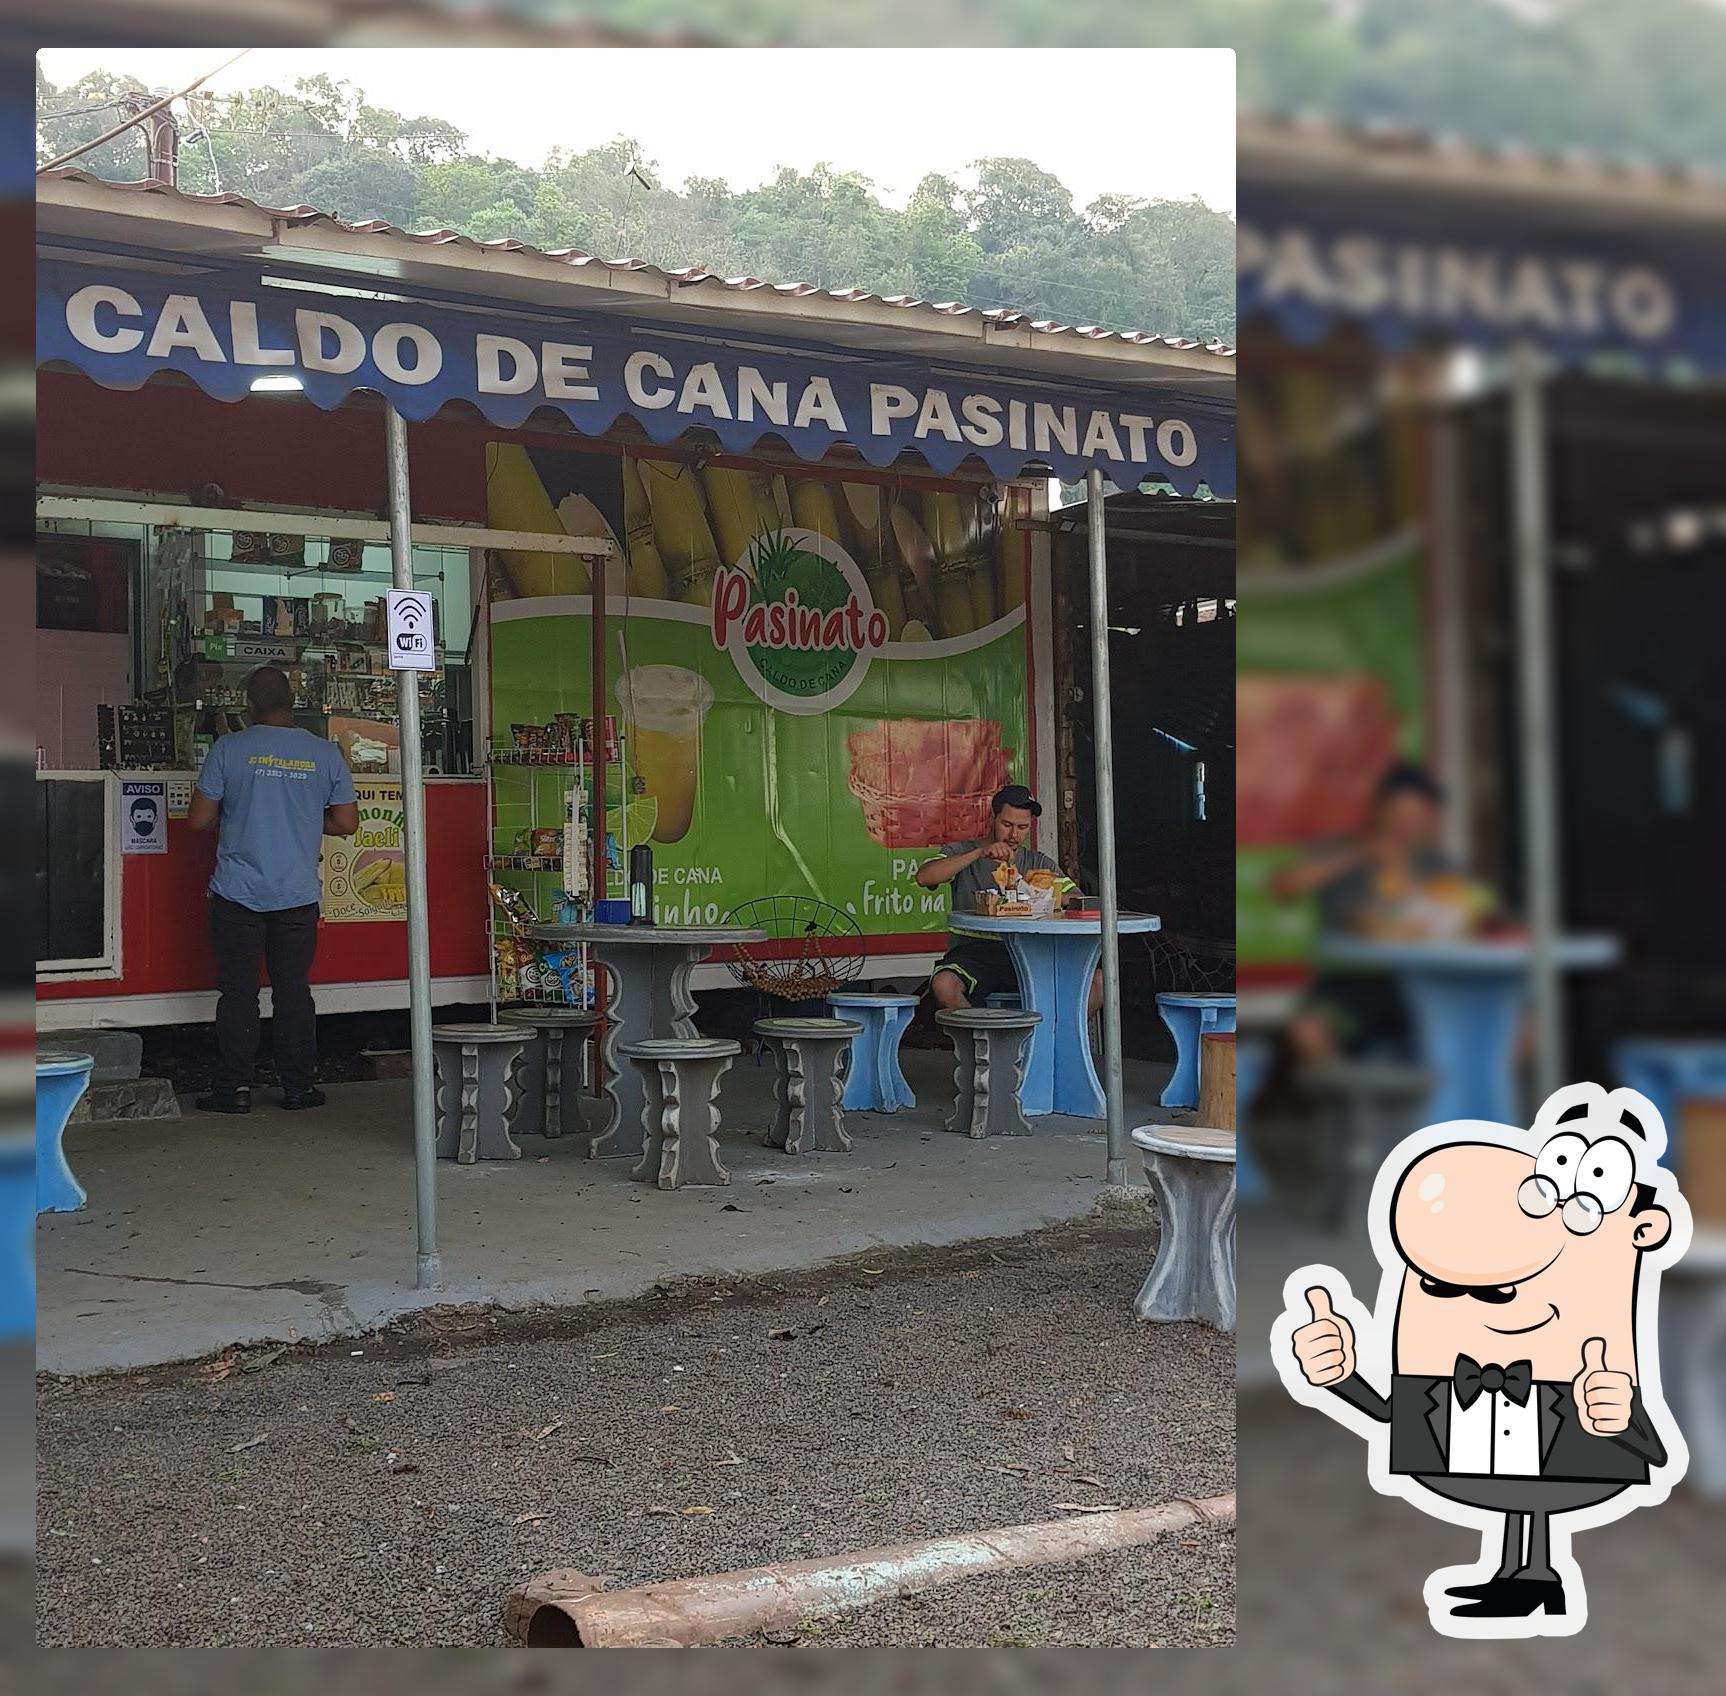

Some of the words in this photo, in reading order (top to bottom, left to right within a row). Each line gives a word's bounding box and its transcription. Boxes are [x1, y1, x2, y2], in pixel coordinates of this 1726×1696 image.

[65, 284, 443, 386] CALDO
[476, 332, 600, 402] DE
[624, 351, 848, 433] CANA
[870, 383, 1198, 467] PASINATO
[714, 568, 888, 650] Pasinato
[243, 646, 286, 657] CAIXA
[759, 657, 797, 689] CALDO
[800, 679, 816, 690] DE
[818, 660, 848, 686] CANA
[126, 784, 161, 794] AVISO
[355, 790, 376, 800] QUI
[673, 867, 724, 885] CANA
[863, 880, 914, 915] Frito
[920, 893, 945, 914] na
[332, 902, 356, 918] Doce
